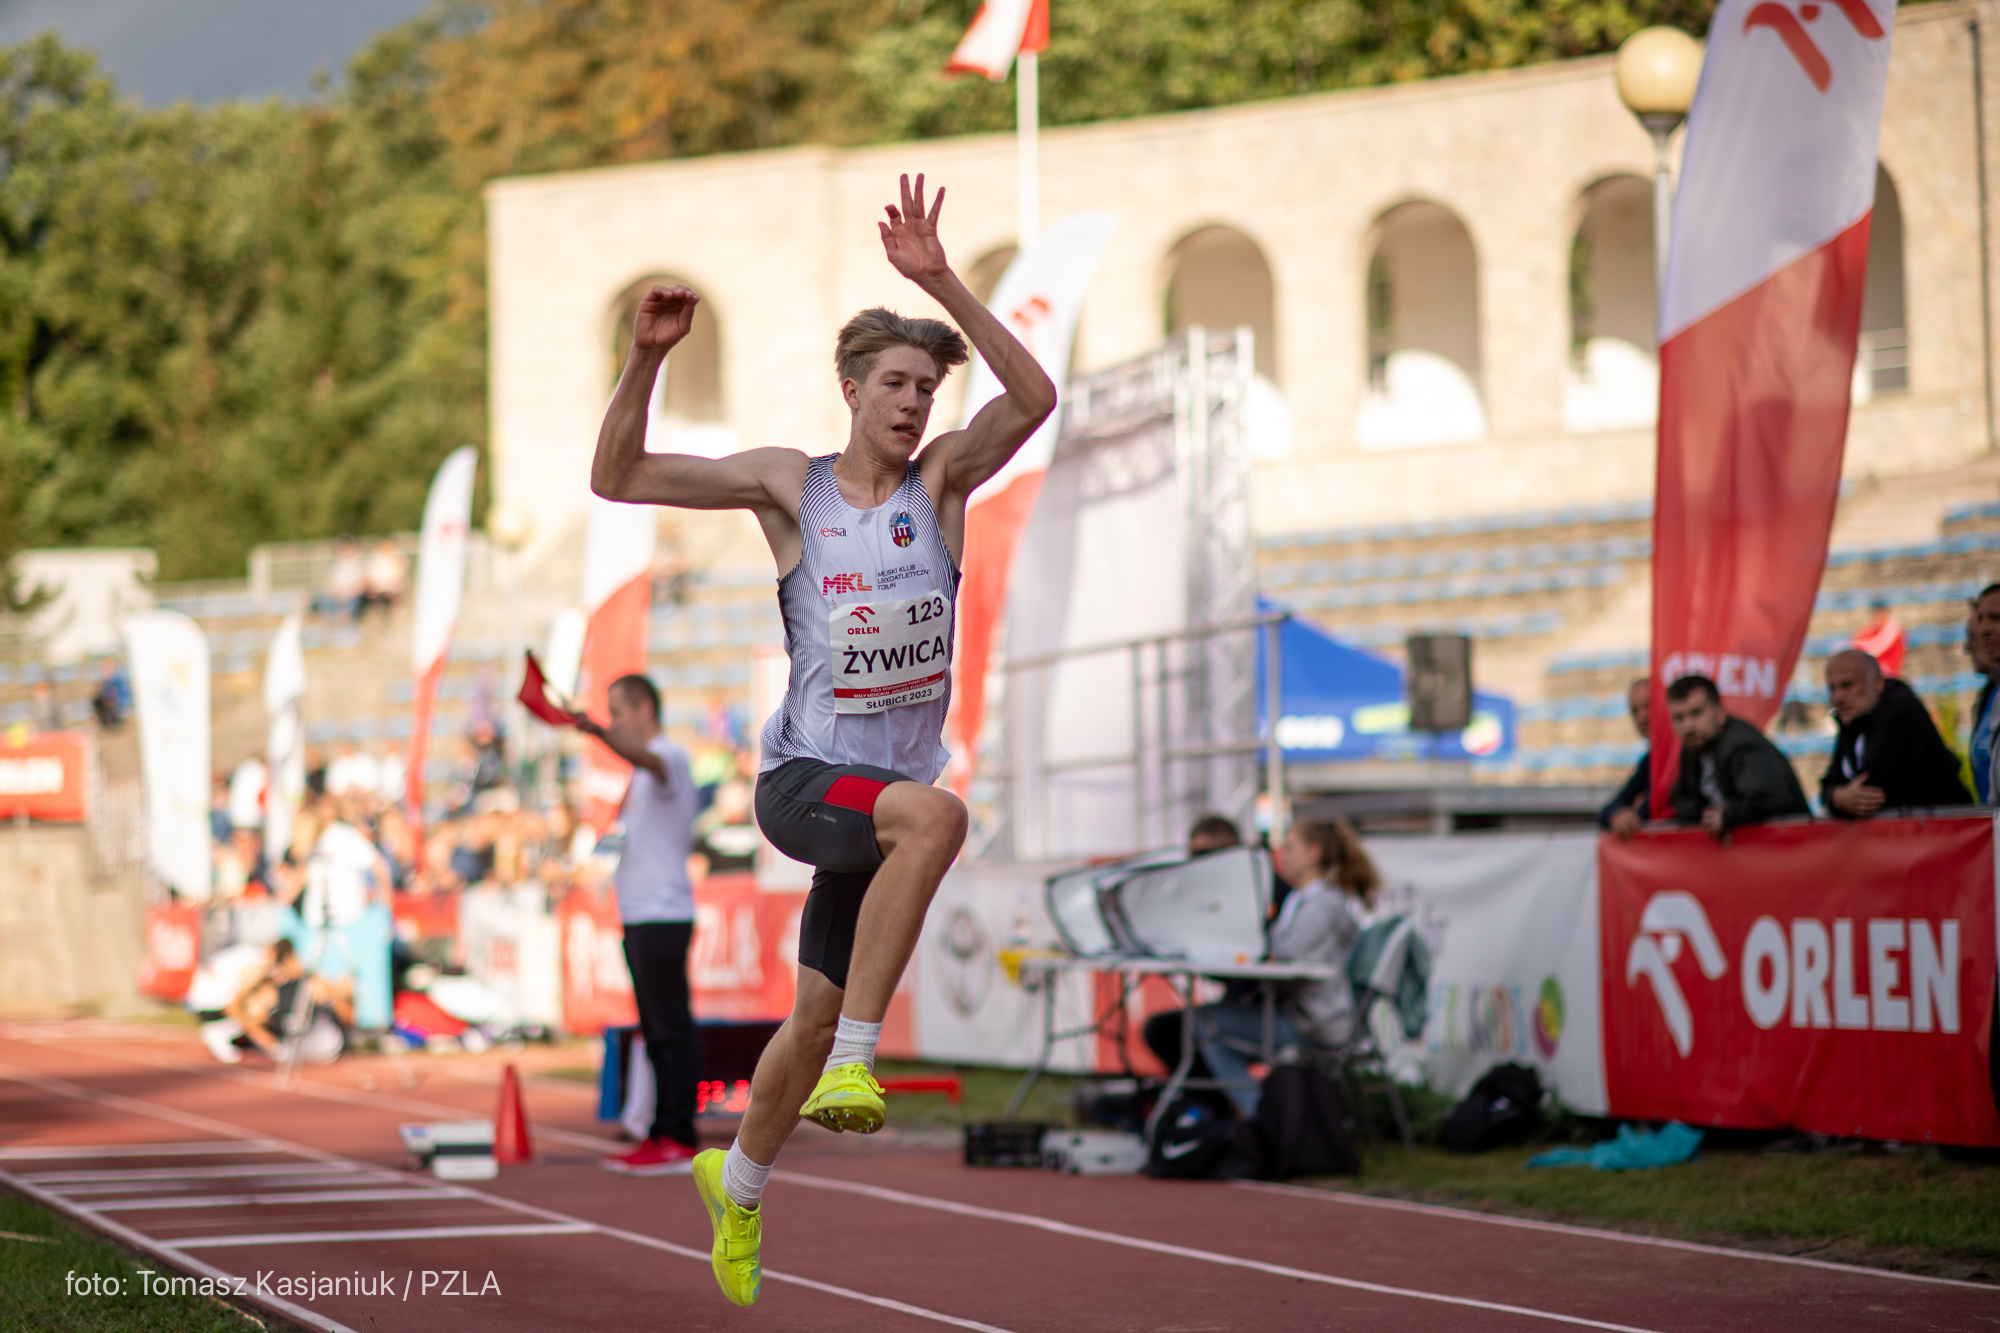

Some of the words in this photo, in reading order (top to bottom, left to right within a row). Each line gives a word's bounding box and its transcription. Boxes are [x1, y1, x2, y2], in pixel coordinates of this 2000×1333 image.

[820, 527, 847, 538] esa
[877, 569, 931, 585] LEKKOATLETYCZN
[898, 564, 916, 573] KLUB
[822, 572, 873, 596] MKL
[906, 596, 945, 626] 123
[847, 626, 880, 636] ORLEN
[843, 635, 946, 675] ŻYWICA
[866, 695, 908, 709] SŁUBICE
[909, 688, 933, 701] 2023
[1740, 914, 1961, 1035] ORLEN
